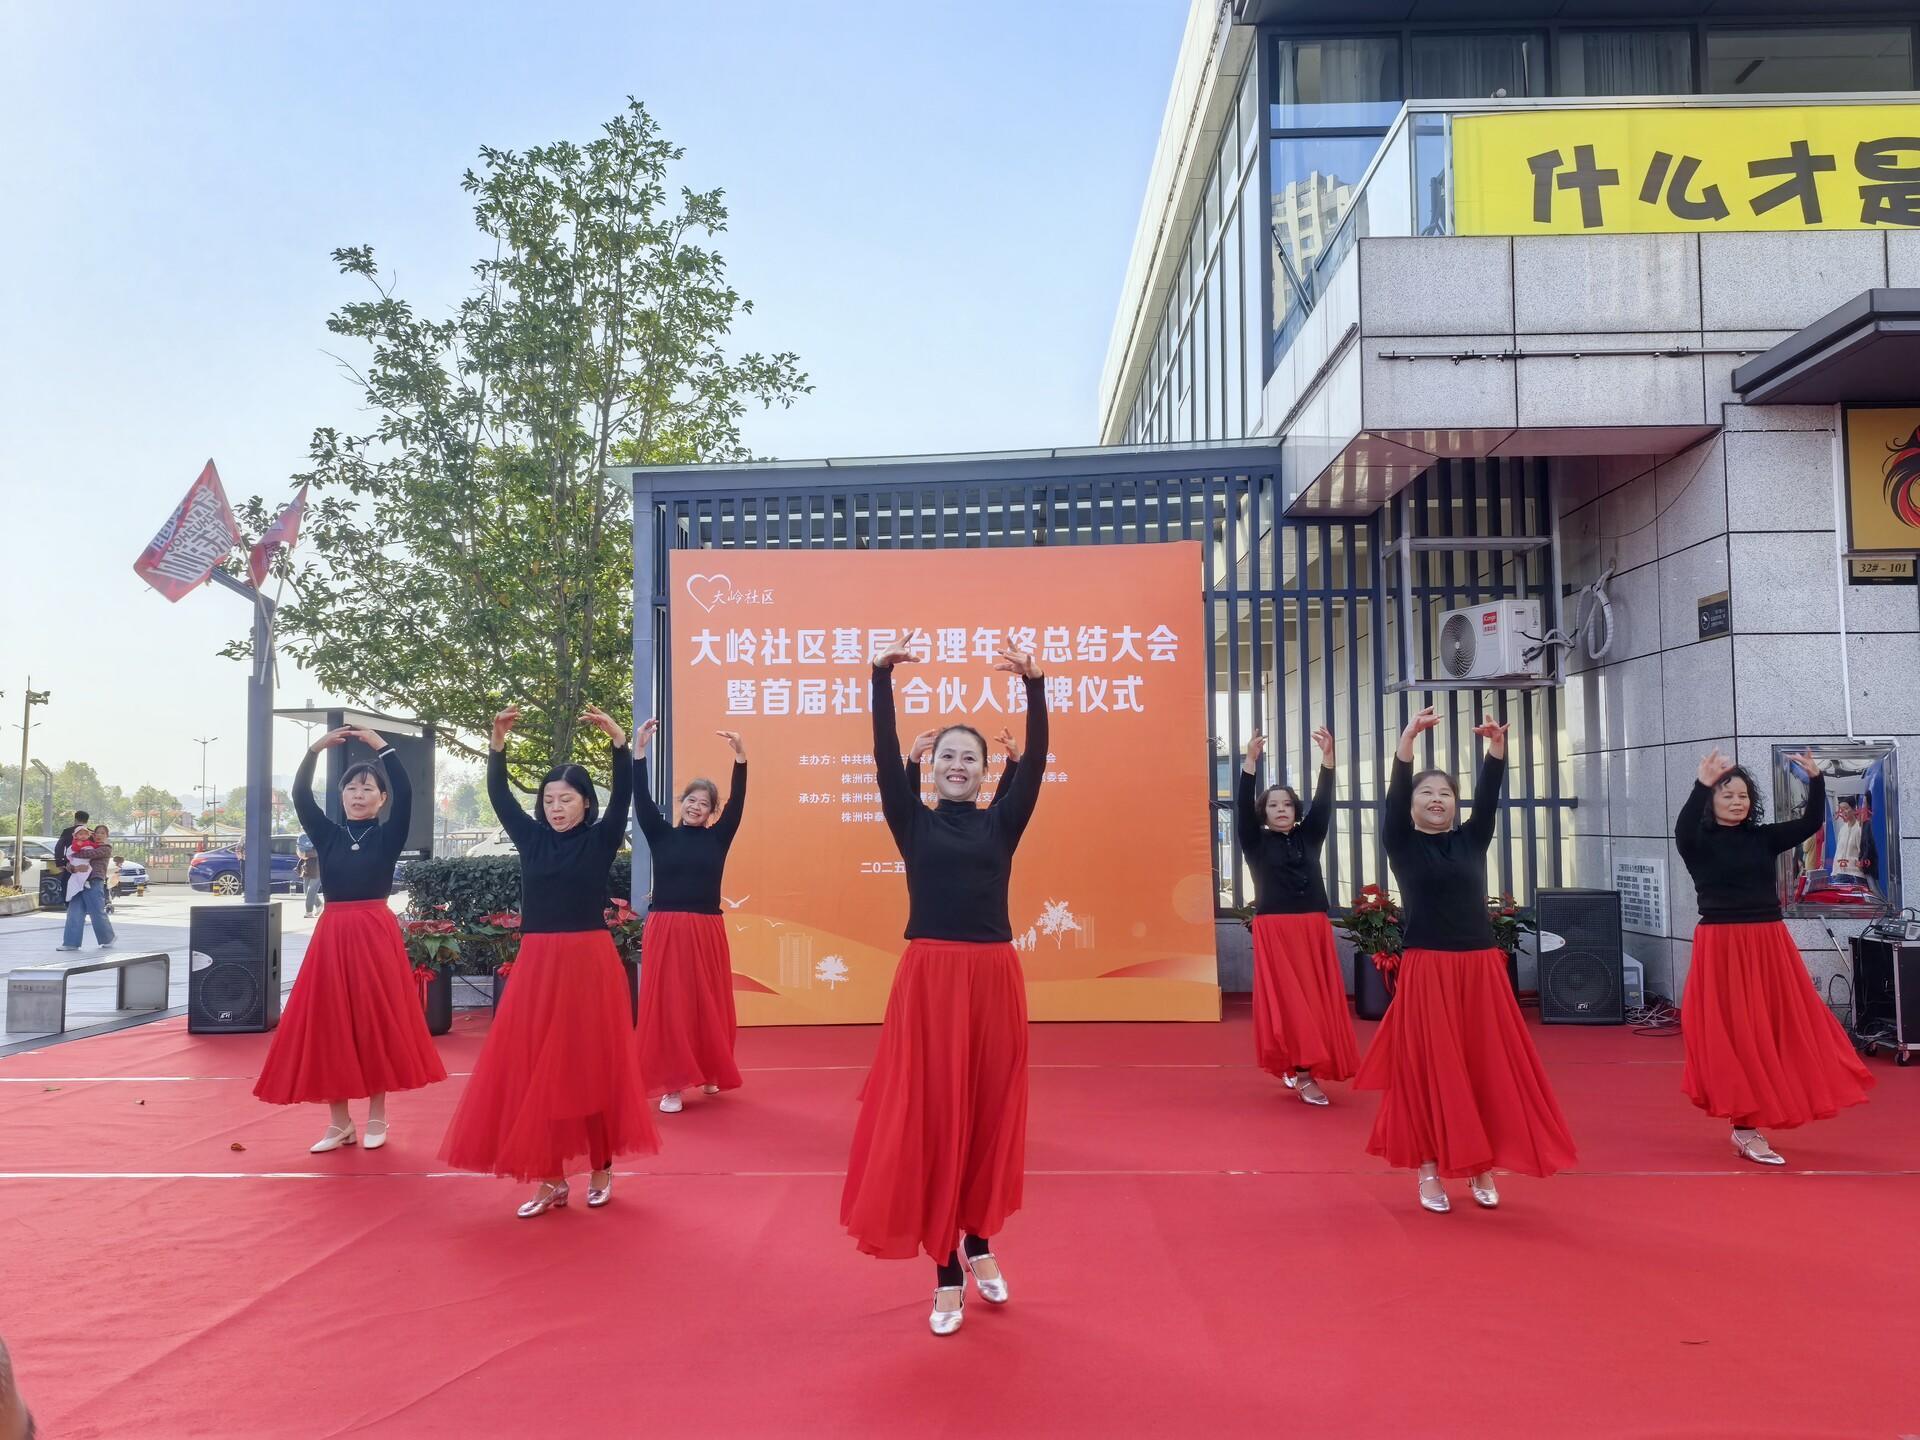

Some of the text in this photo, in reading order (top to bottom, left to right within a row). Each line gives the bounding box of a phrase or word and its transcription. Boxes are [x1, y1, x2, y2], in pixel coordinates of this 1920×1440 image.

[1527, 137, 1920, 228] 什么才是
[711, 588, 775, 605] 大岭社区
[725, 674, 1144, 715] 暨首届社合伙人授牌仪式
